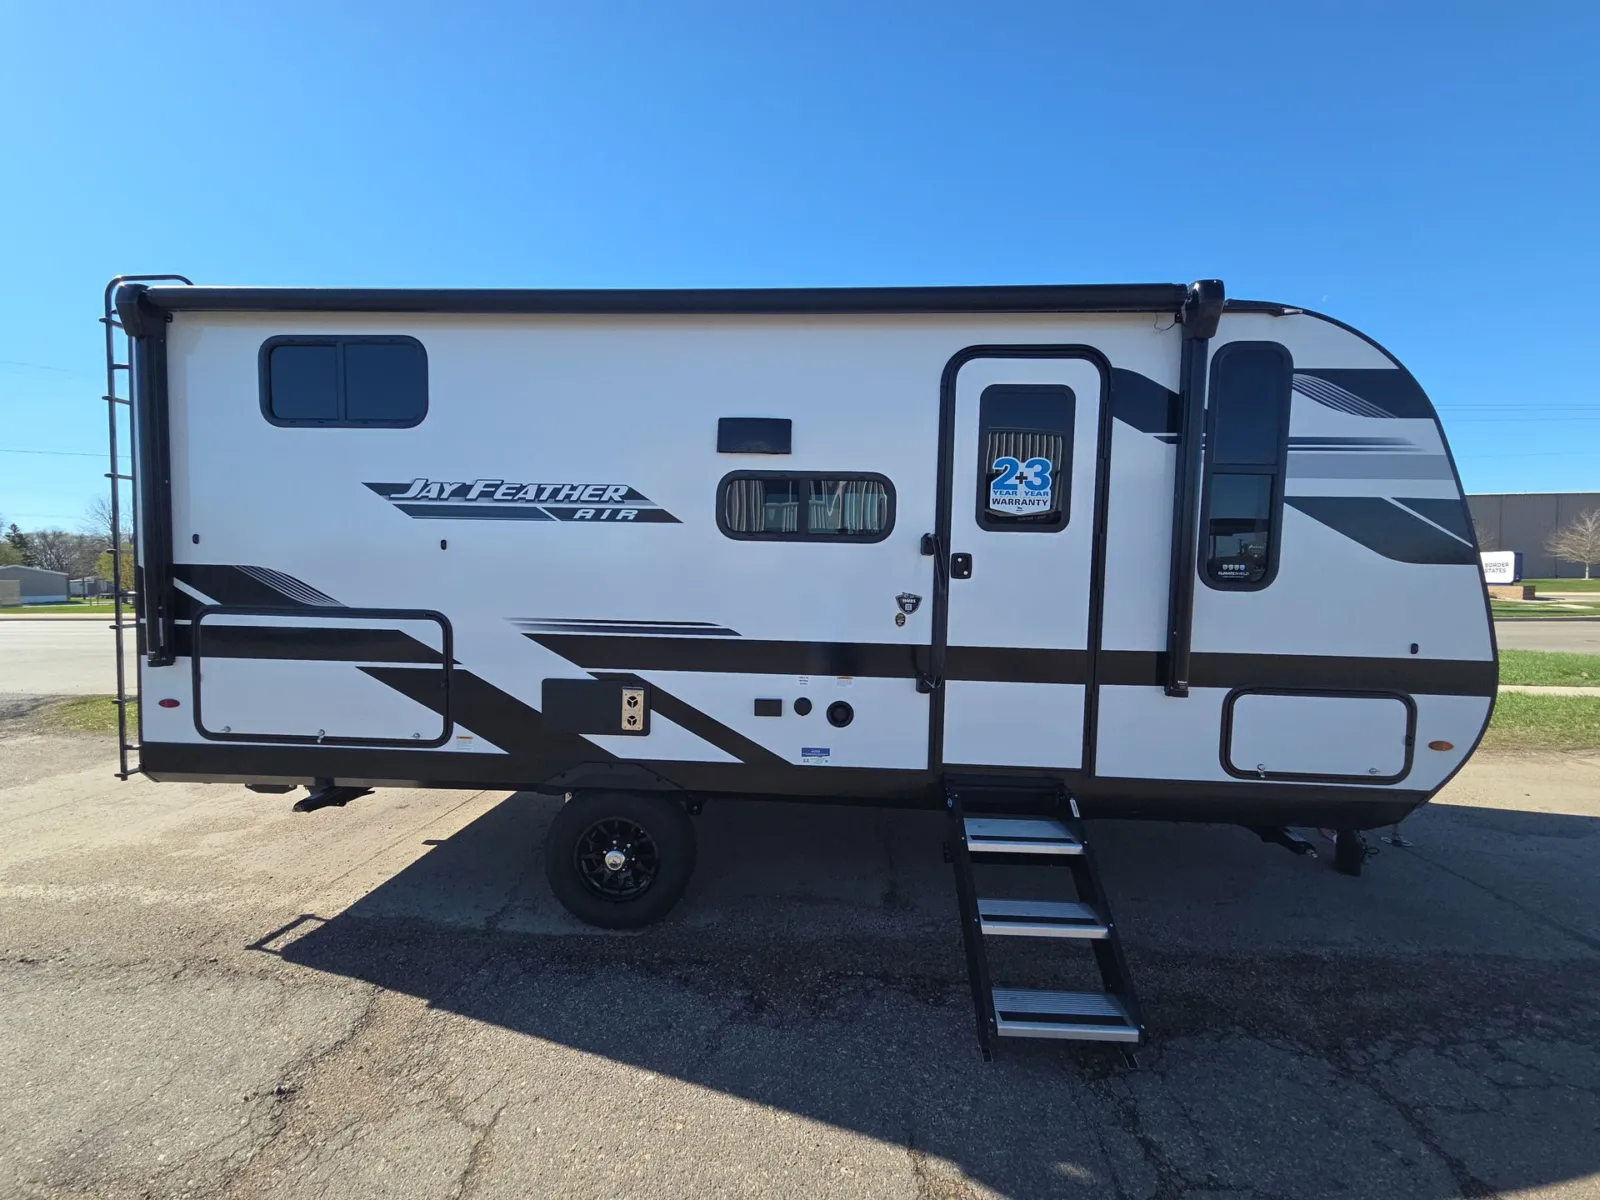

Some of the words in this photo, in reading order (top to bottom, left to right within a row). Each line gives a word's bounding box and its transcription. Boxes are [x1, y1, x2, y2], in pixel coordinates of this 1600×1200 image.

[390, 478, 464, 502] JAY
[467, 479, 630, 504] FEATHER
[992, 498, 1049, 506] WARRANTY
[572, 508, 639, 521] AIR
